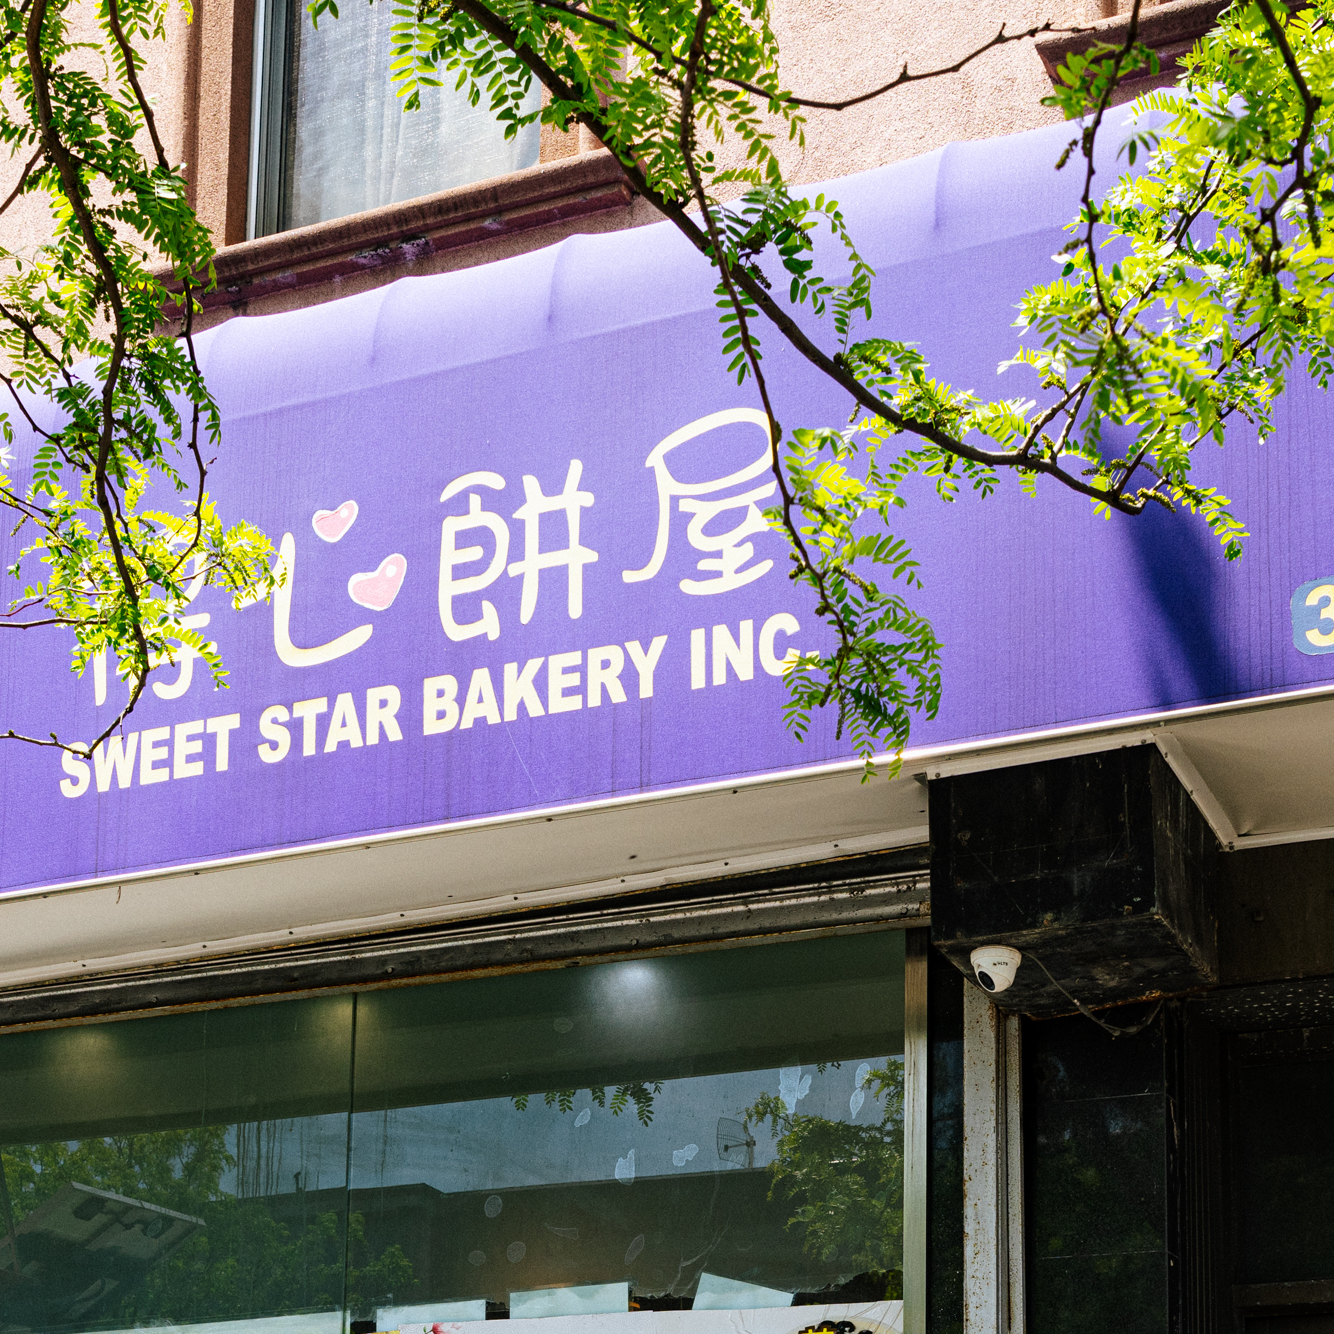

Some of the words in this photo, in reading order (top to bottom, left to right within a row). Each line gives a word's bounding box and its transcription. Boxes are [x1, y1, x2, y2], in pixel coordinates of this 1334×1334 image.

[59, 712, 241, 799] SWEET
[258, 686, 403, 764] STAR
[423, 634, 669, 737] BAKERY
